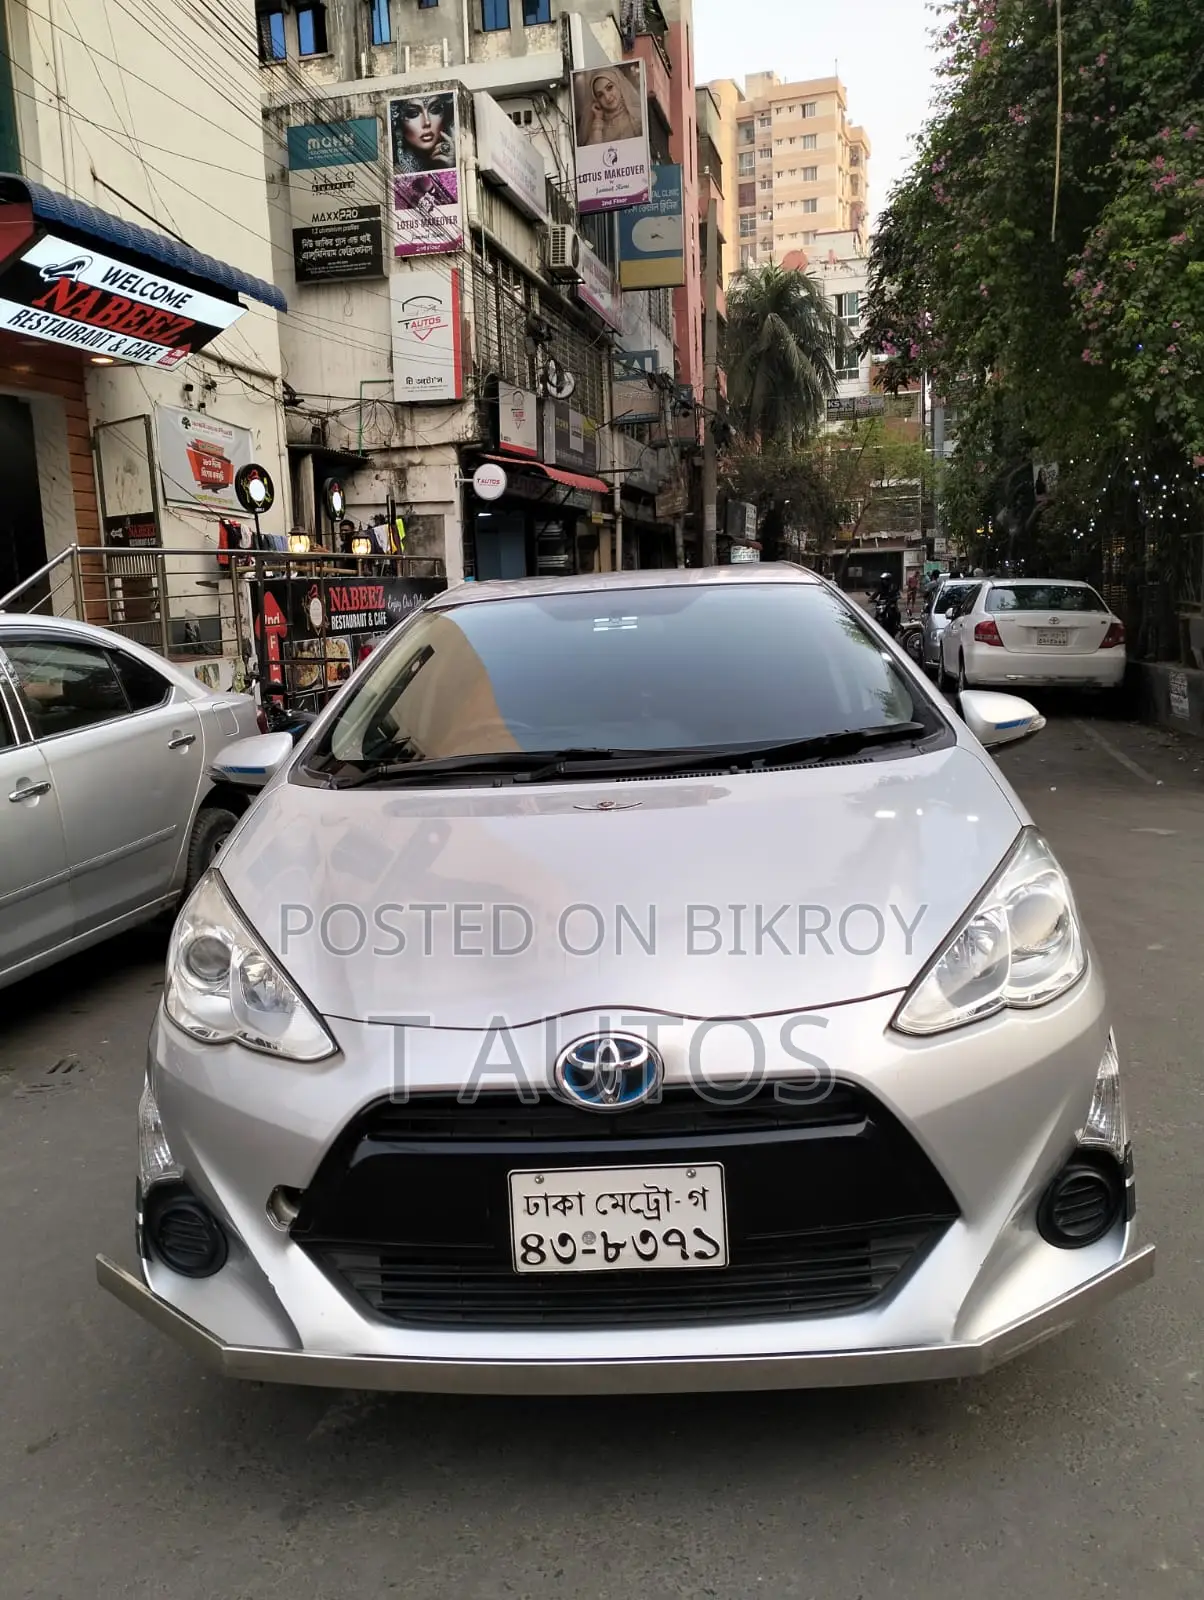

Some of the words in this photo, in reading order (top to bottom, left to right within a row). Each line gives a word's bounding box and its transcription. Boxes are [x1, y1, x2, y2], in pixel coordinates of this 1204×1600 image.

[578, 171, 602, 184] LOTUS
[604, 164, 645, 179] MAKEOVER
[101, 266, 193, 310] WELCOME
[31, 276, 197, 345] NABEEZ
[411, 316, 441, 329] AUTOS
[8, 309, 111, 349] RESTAURANT
[110, 338, 124, 353] &
[123, 340, 163, 362] CAFE
[329, 586, 385, 612] NABEEZ
[331, 612, 367, 630] RESTAURANT
[374, 611, 387, 626] CAFE
[523, 1191, 586, 1217] ঢাকা
[520, 1227, 721, 1265] ৪৩-৮৩৭১
